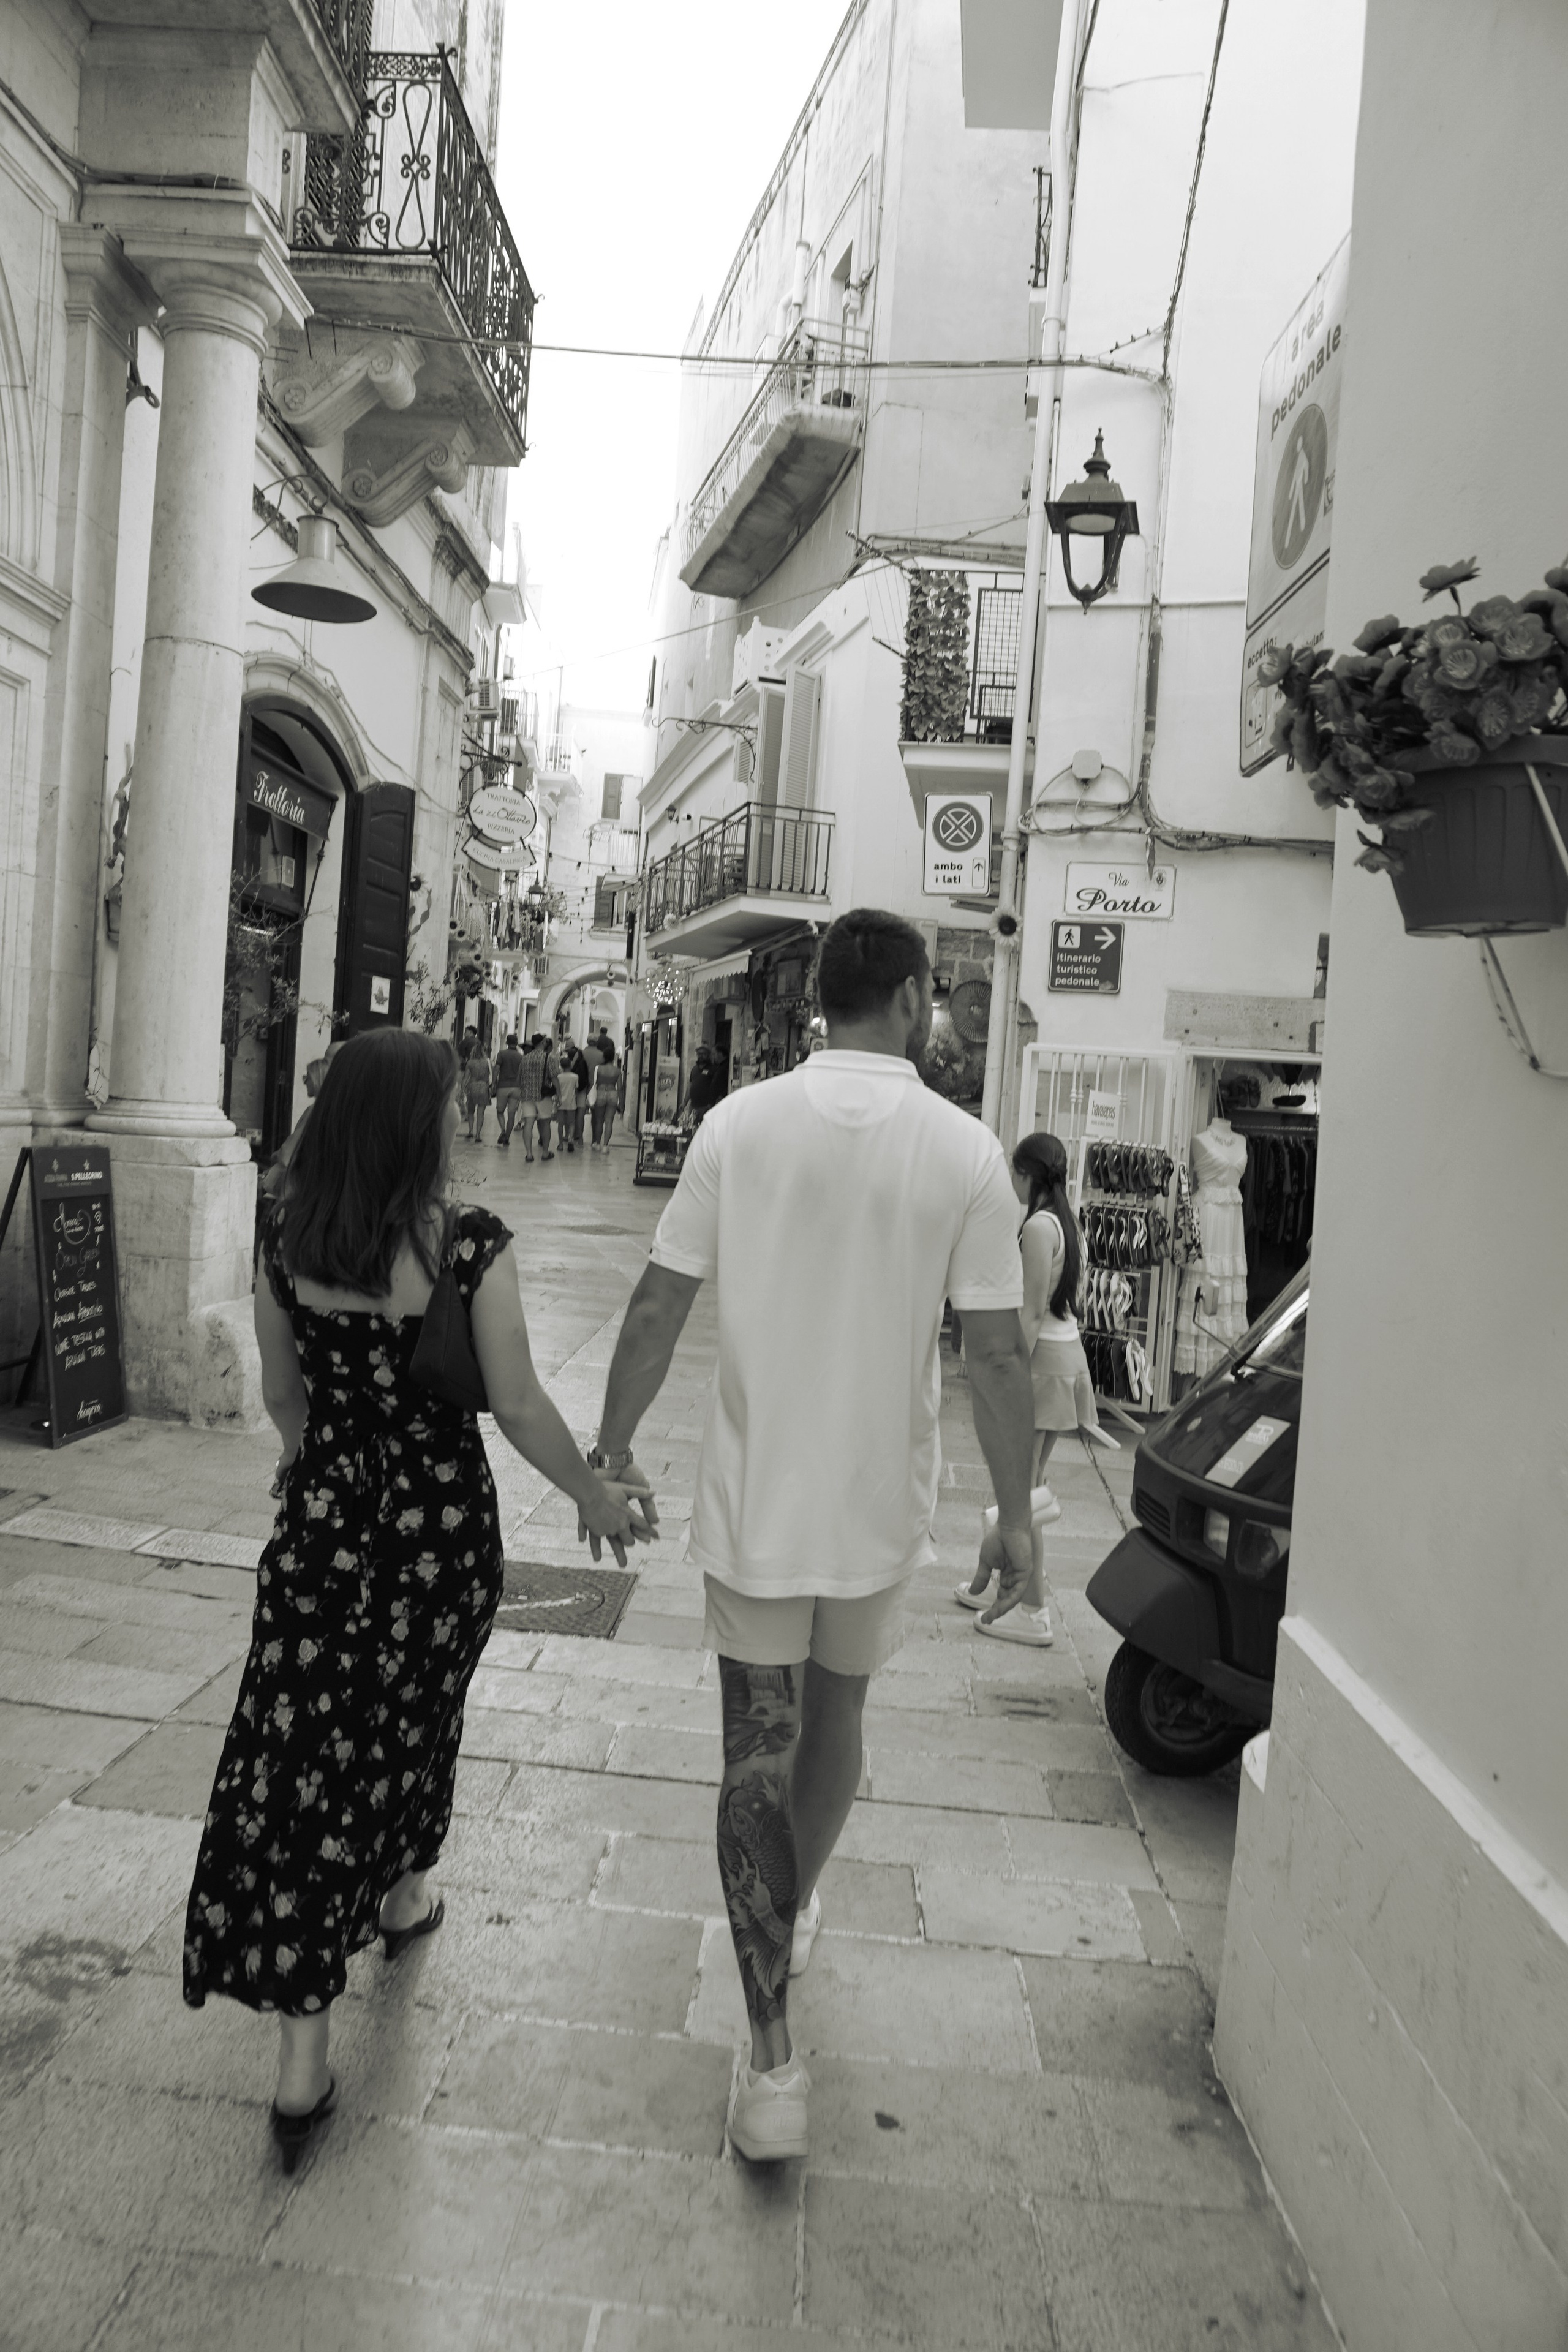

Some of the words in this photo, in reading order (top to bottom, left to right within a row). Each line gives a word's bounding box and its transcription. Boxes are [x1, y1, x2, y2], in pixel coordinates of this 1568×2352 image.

[1292, 300, 1324, 363] area
[1270, 323, 1341, 443] pedonale
[254, 771, 305, 825] Trattoria
[487, 793, 521, 806] TRATTORIA
[497, 807, 530, 825] Ottavio
[488, 823, 515, 834] PIZZERIA
[473, 847, 494, 862] CUCINA
[934, 861, 963, 870] ambo
[935, 875, 938, 883] i
[943, 874, 960, 883] lati
[1109, 872, 1129, 887] Via
[1076, 888, 1162, 913] Porto
[1057, 952, 1101, 963] itinerario
[1057, 964, 1098, 974] turistico
[1055, 976, 1099, 986] pedonale
[1091, 1100, 1115, 1120] havaianas
